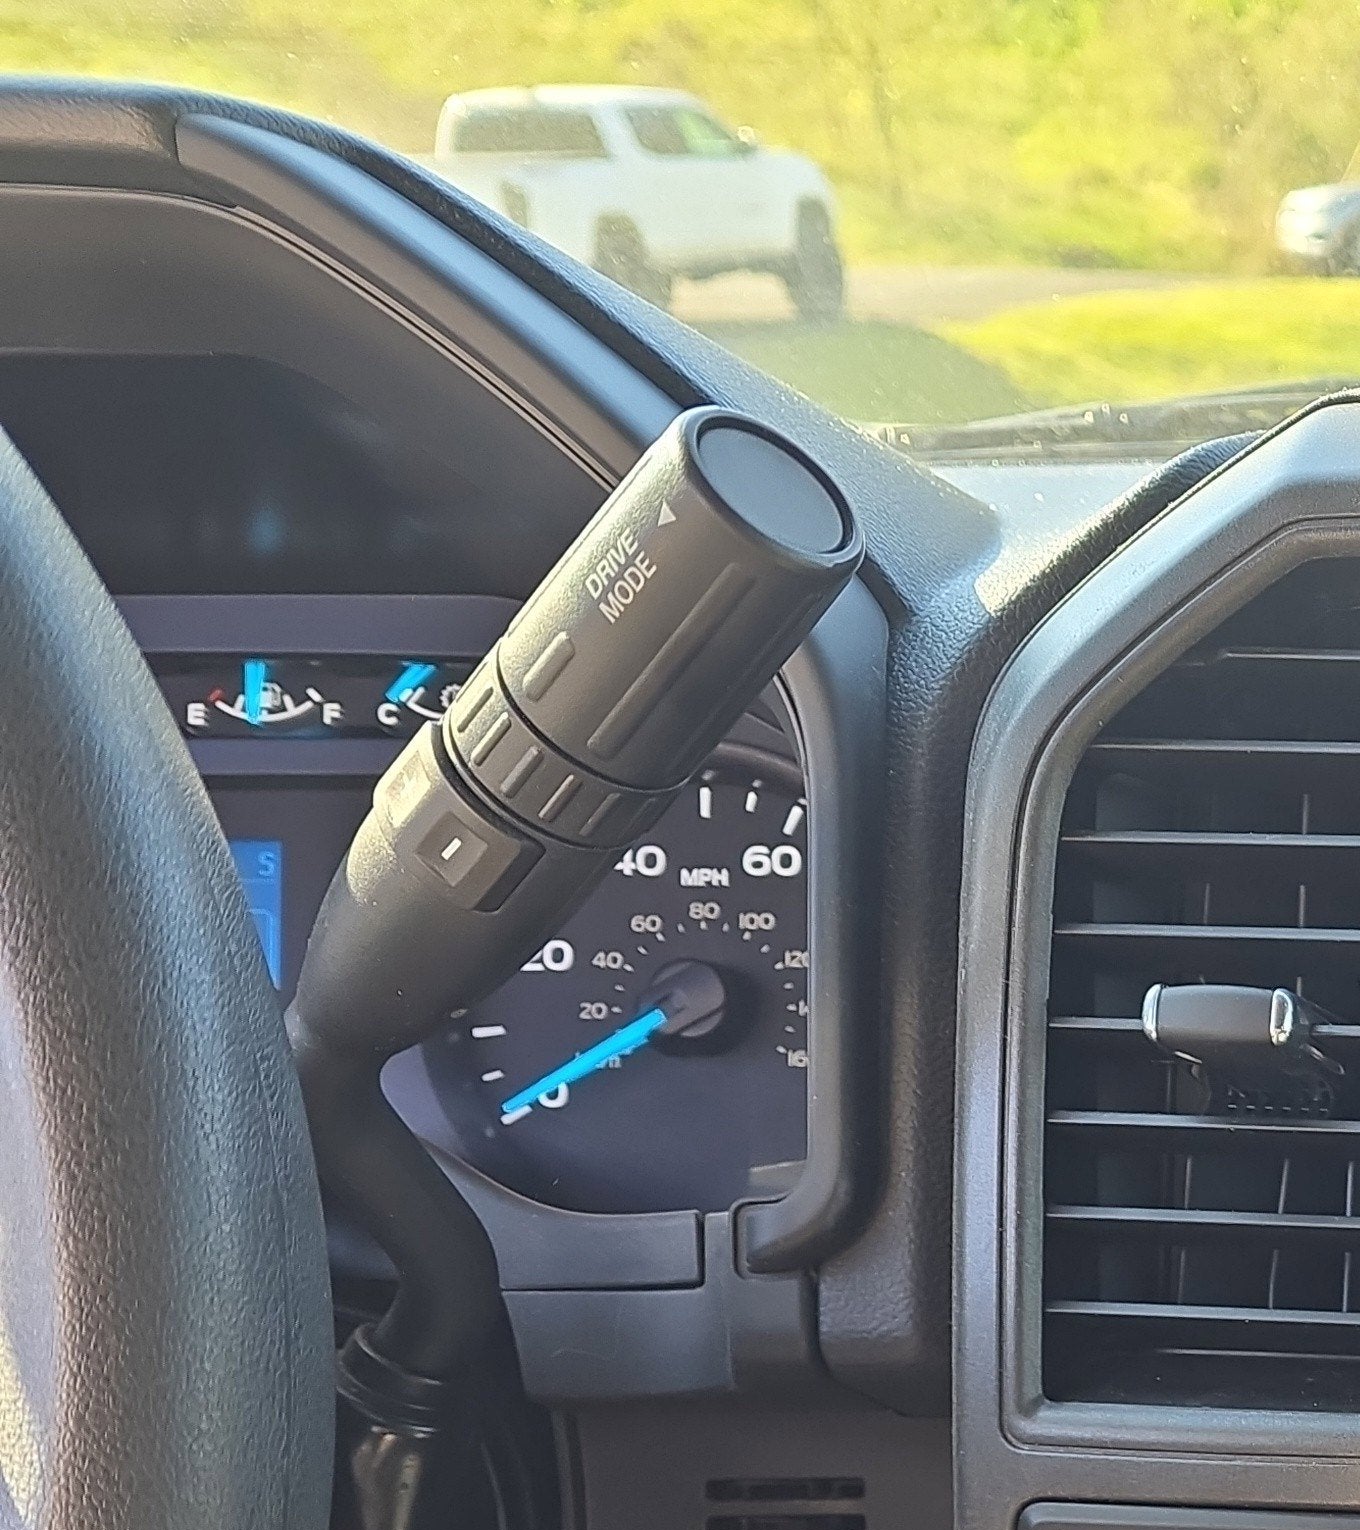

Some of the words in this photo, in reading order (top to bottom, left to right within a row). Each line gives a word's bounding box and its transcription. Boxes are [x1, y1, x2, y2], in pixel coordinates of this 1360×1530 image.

[585, 528, 638, 601] DRIVE
[599, 551, 657, 625] MODE
[187, 702, 208, 725] E
[322, 702, 344, 725] F
[377, 702, 400, 725] C
[742, 845, 802, 877] 60
[680, 867, 731, 888] MPH
[688, 901, 721, 920] 80
[630, 914, 663, 933] 60
[738, 912, 776, 931] 100
[591, 951, 625, 970] 40
[578, 1002, 608, 1020] 20
[787, 1050, 810, 1068] 16
